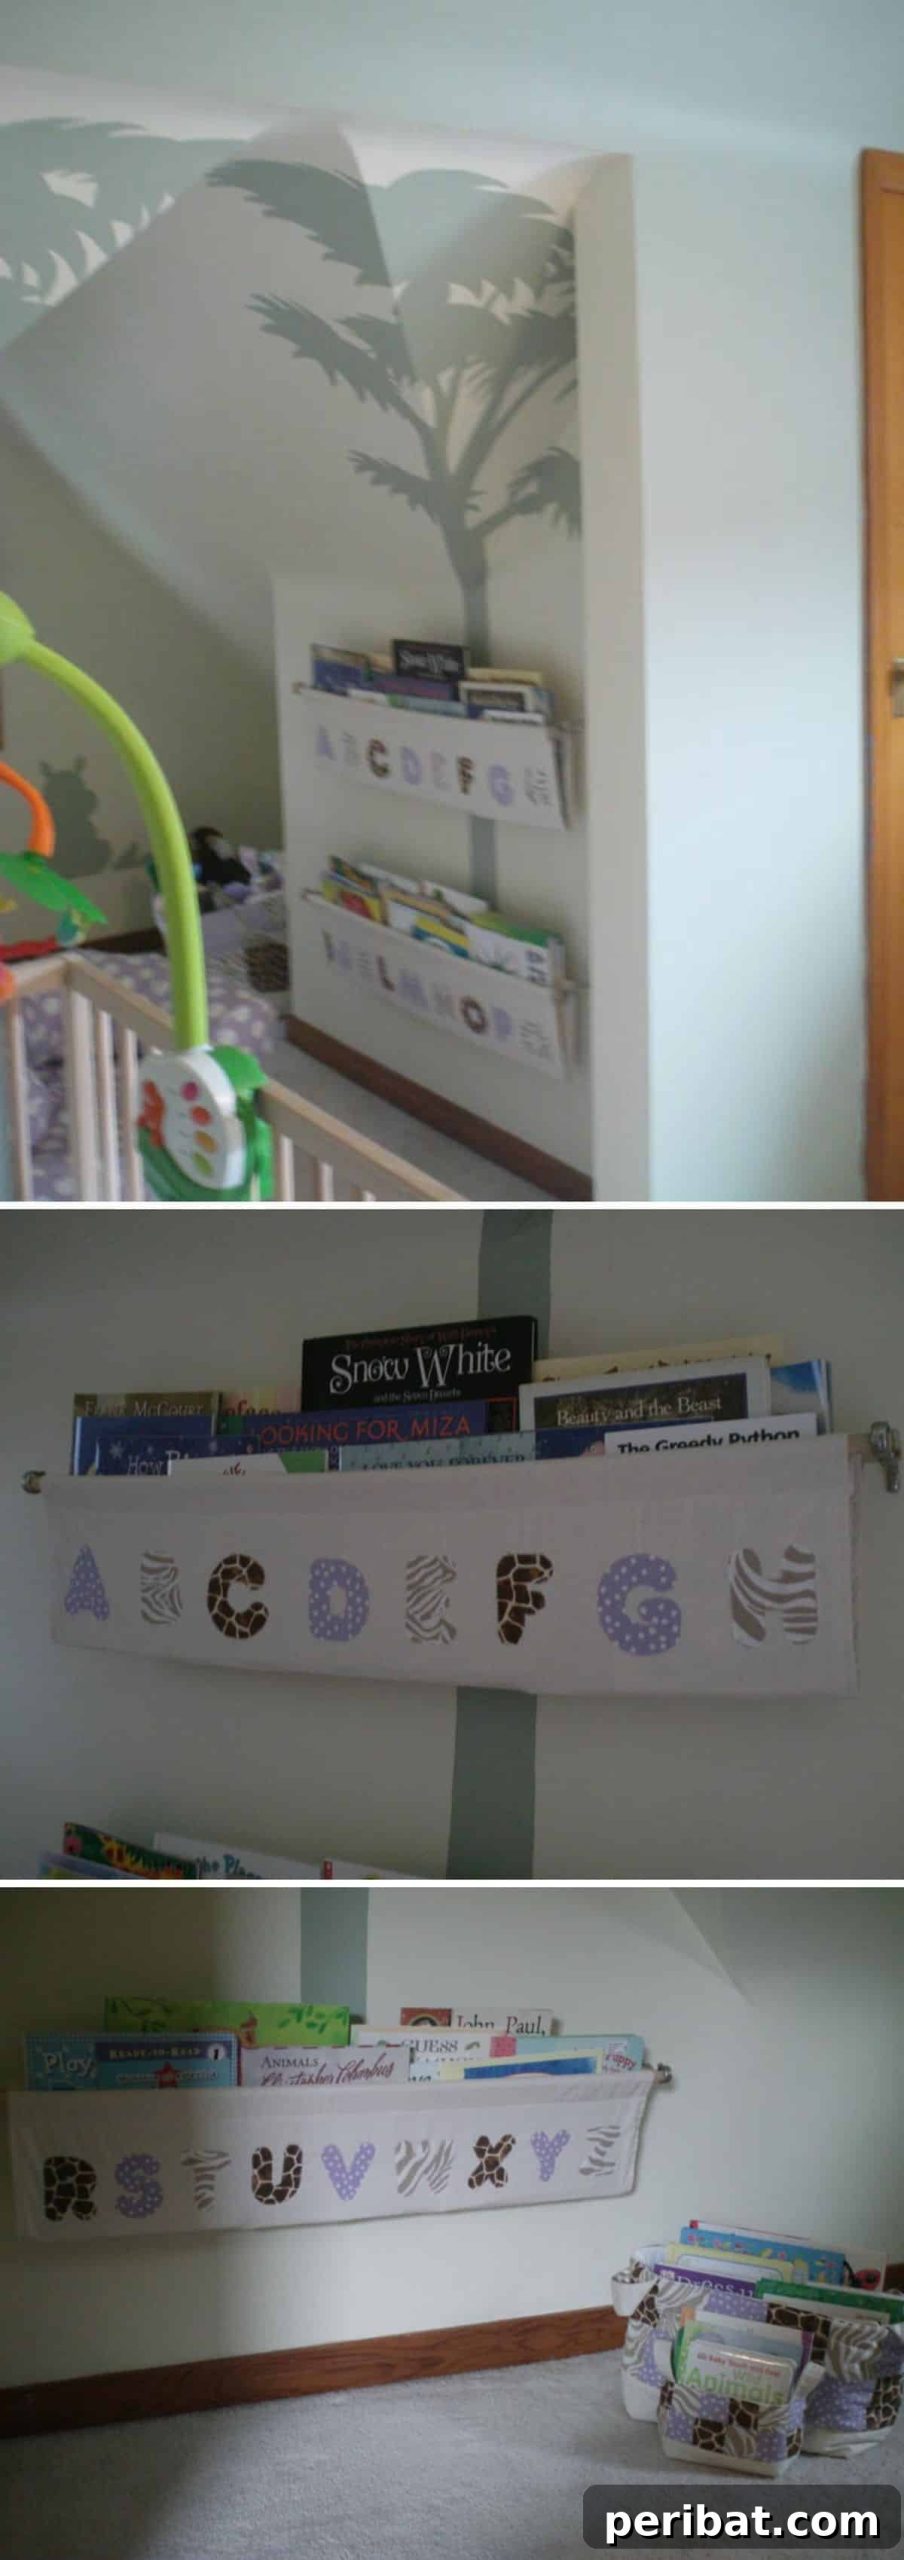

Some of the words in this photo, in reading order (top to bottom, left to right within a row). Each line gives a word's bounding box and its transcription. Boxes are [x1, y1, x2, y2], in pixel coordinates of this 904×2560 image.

[329, 1354, 409, 1395] Snow
[416, 1342, 511, 1389] White
[557, 1409, 608, 1427] Beauty
[615, 1400, 644, 1421] and
[649, 1399, 672, 1417] the
[677, 1396, 723, 1415] Beast
[260, 1422, 350, 1445] OOKING
[356, 1420, 405, 1442] FOR
[411, 1415, 471, 1438] MIZA
[617, 1442, 650, 1454] The
[64, 1543, 110, 1622] A
[207, 1552, 270, 1640] C
[308, 1556, 371, 1643] D
[496, 1552, 554, 1645] F
[597, 1552, 682, 1657] G
[506, 2015, 547, 2037] Paul,
[44, 2156, 96, 2221] R
[115, 2154, 163, 2219] S
[252, 2144, 303, 2205] U
[321, 2142, 376, 2201] V
[468, 2133, 516, 2189] X
[530, 2128, 571, 2182] Y
